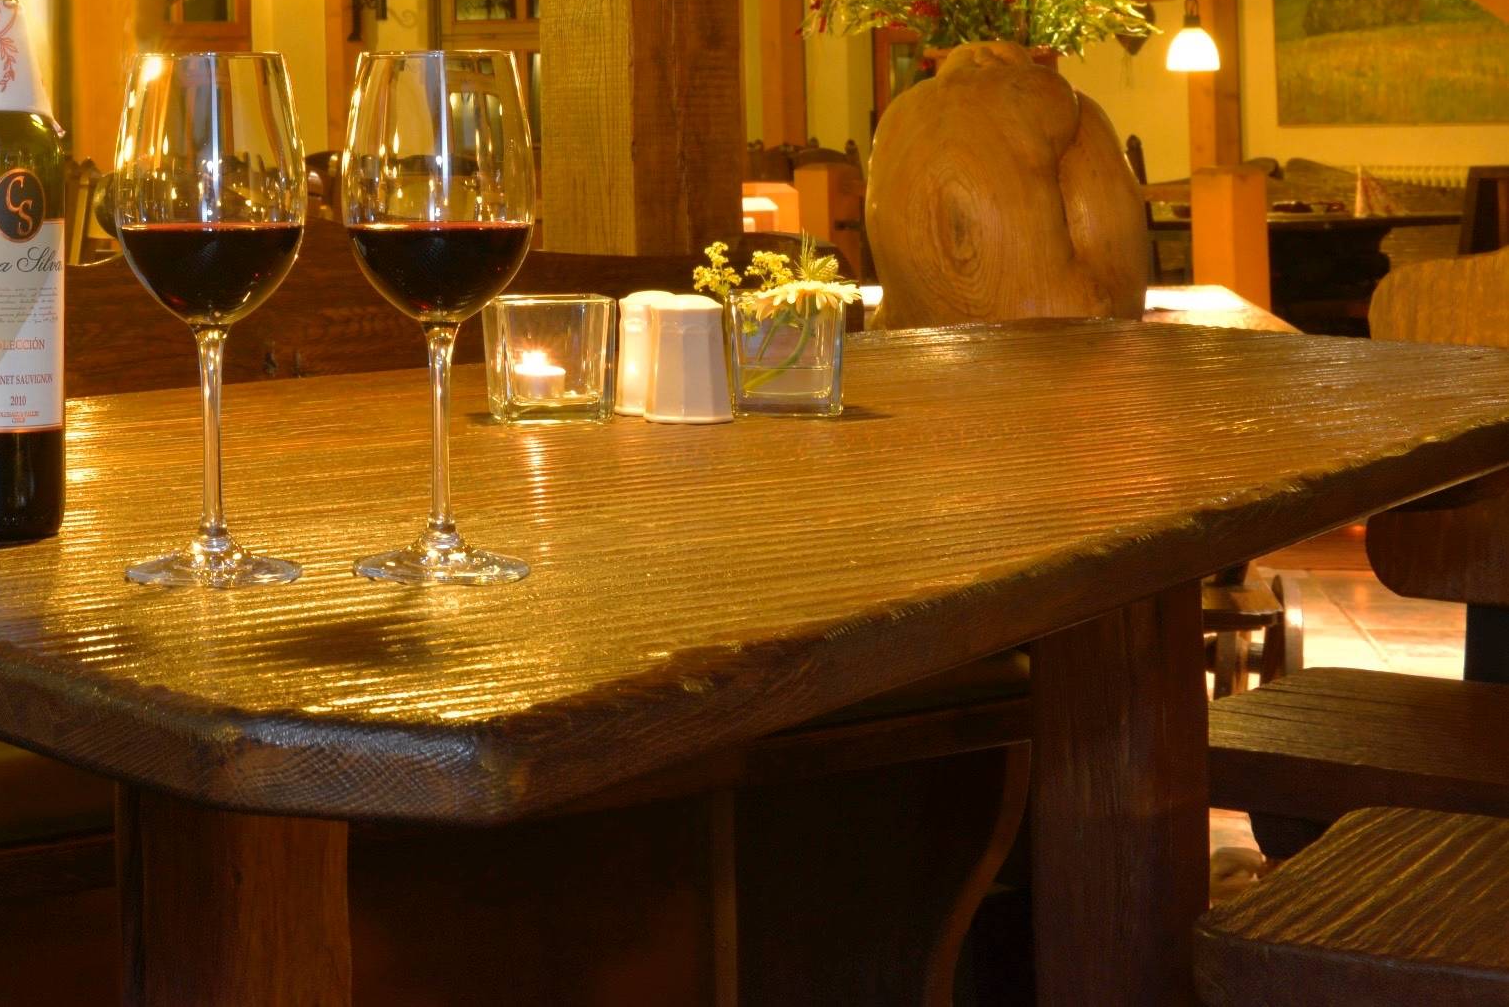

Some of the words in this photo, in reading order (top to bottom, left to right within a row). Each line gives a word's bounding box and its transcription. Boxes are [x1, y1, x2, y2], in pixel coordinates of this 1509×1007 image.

[16, 246, 62, 273] Silva
[16, 374, 53, 385] SAUVIGNON
[10, 395, 27, 406] 2010
